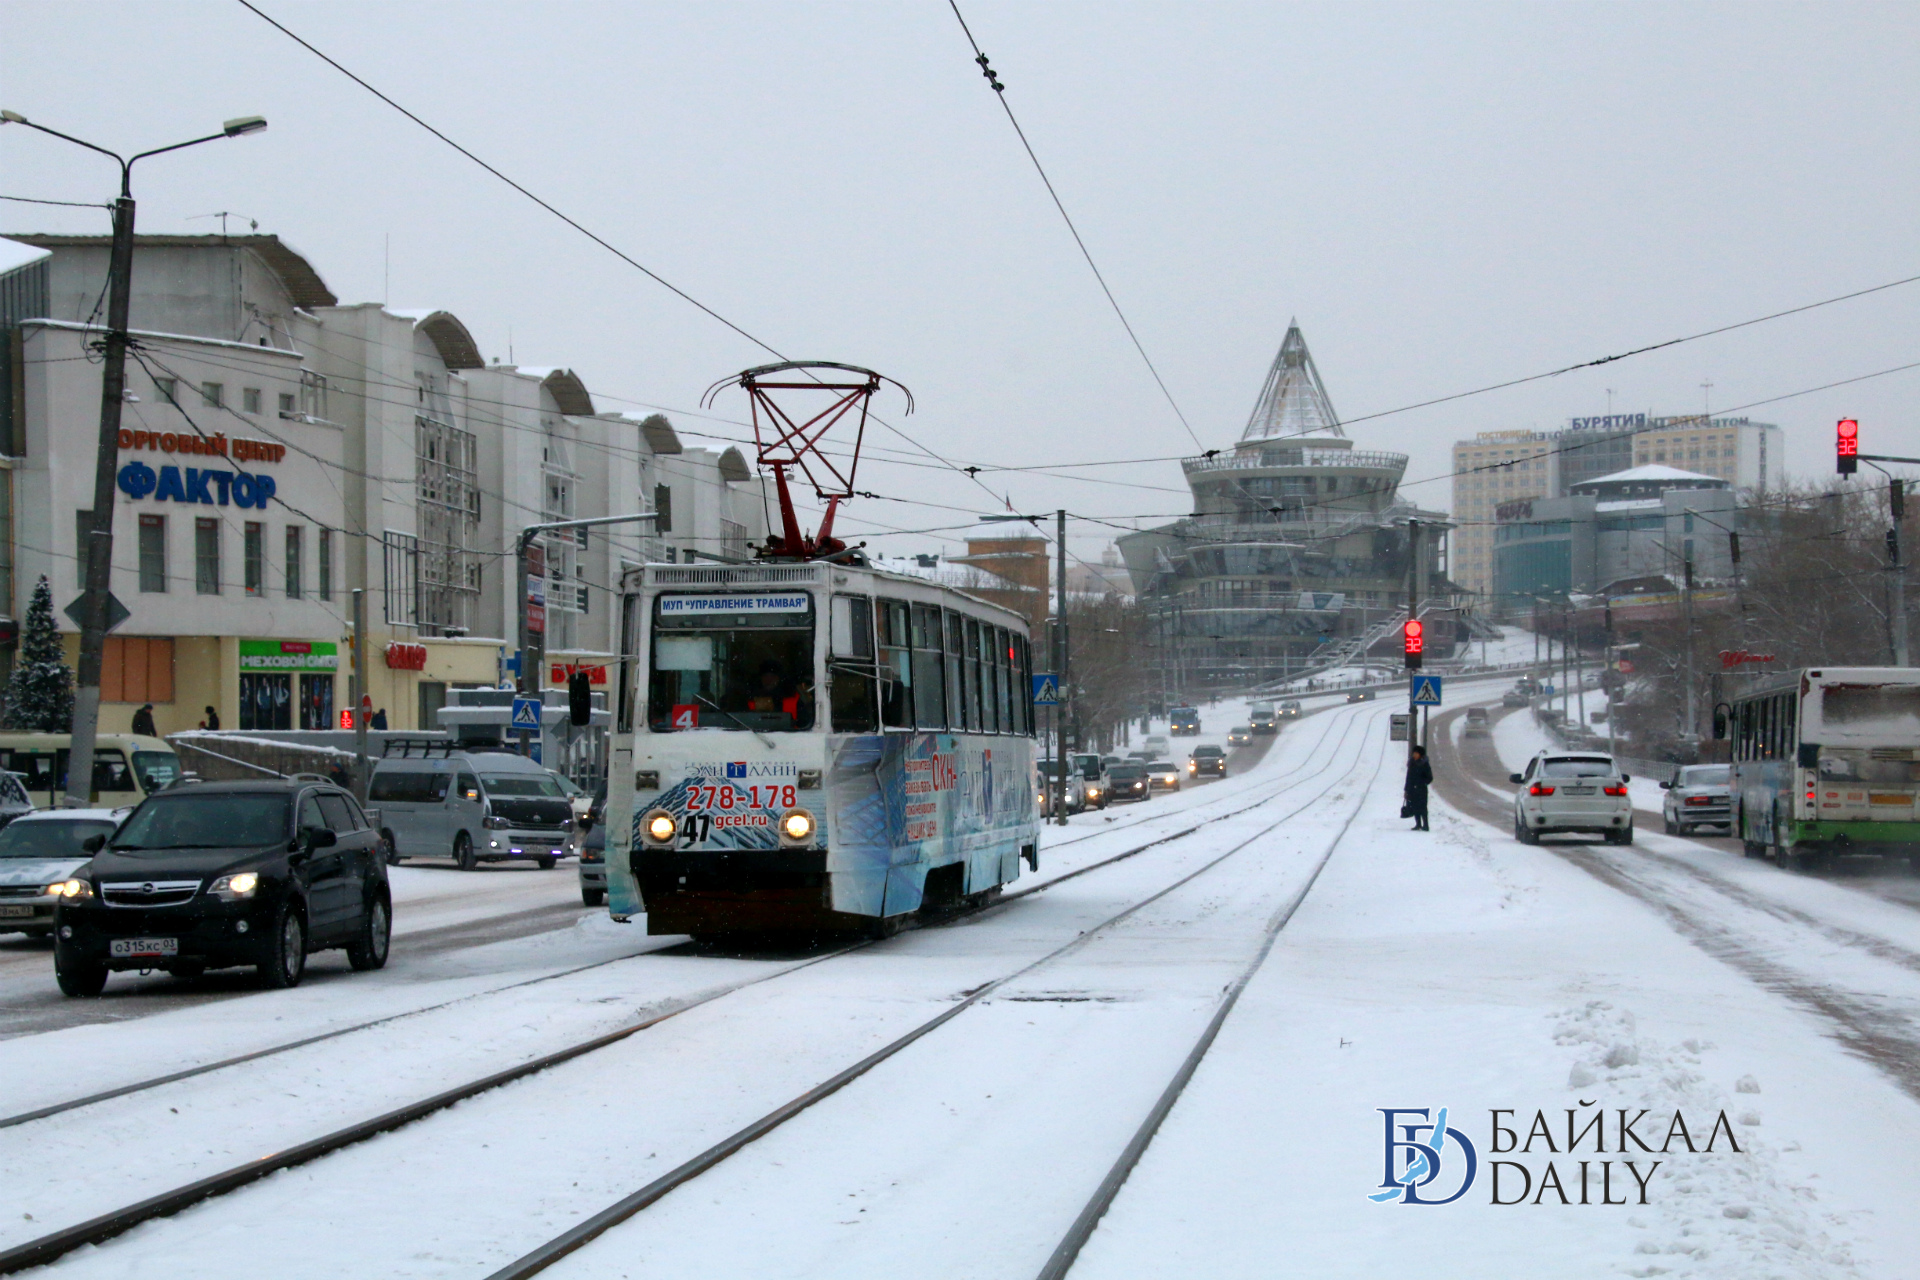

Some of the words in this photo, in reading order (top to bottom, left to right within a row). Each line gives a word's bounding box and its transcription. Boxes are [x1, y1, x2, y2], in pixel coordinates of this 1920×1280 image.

[1572, 413, 1645, 430] БУРЯТИЯ
[118, 429, 228, 457] ОРГОВЫЙ
[233, 438, 286, 463] ЦЕНТР
[1838, 438, 1858, 455] 32
[117, 461, 276, 509] ФАКТОР
[662, 600, 683, 611] МУП
[1405, 637, 1422, 653] 32
[241, 653, 305, 667] МЕХОВОЙ
[676, 710, 694, 729] 4
[686, 785, 797, 810] 278-178
[682, 815, 710, 842] 47
[715, 814, 768, 830] gcel.ru
[163, 940, 175, 948] 03
